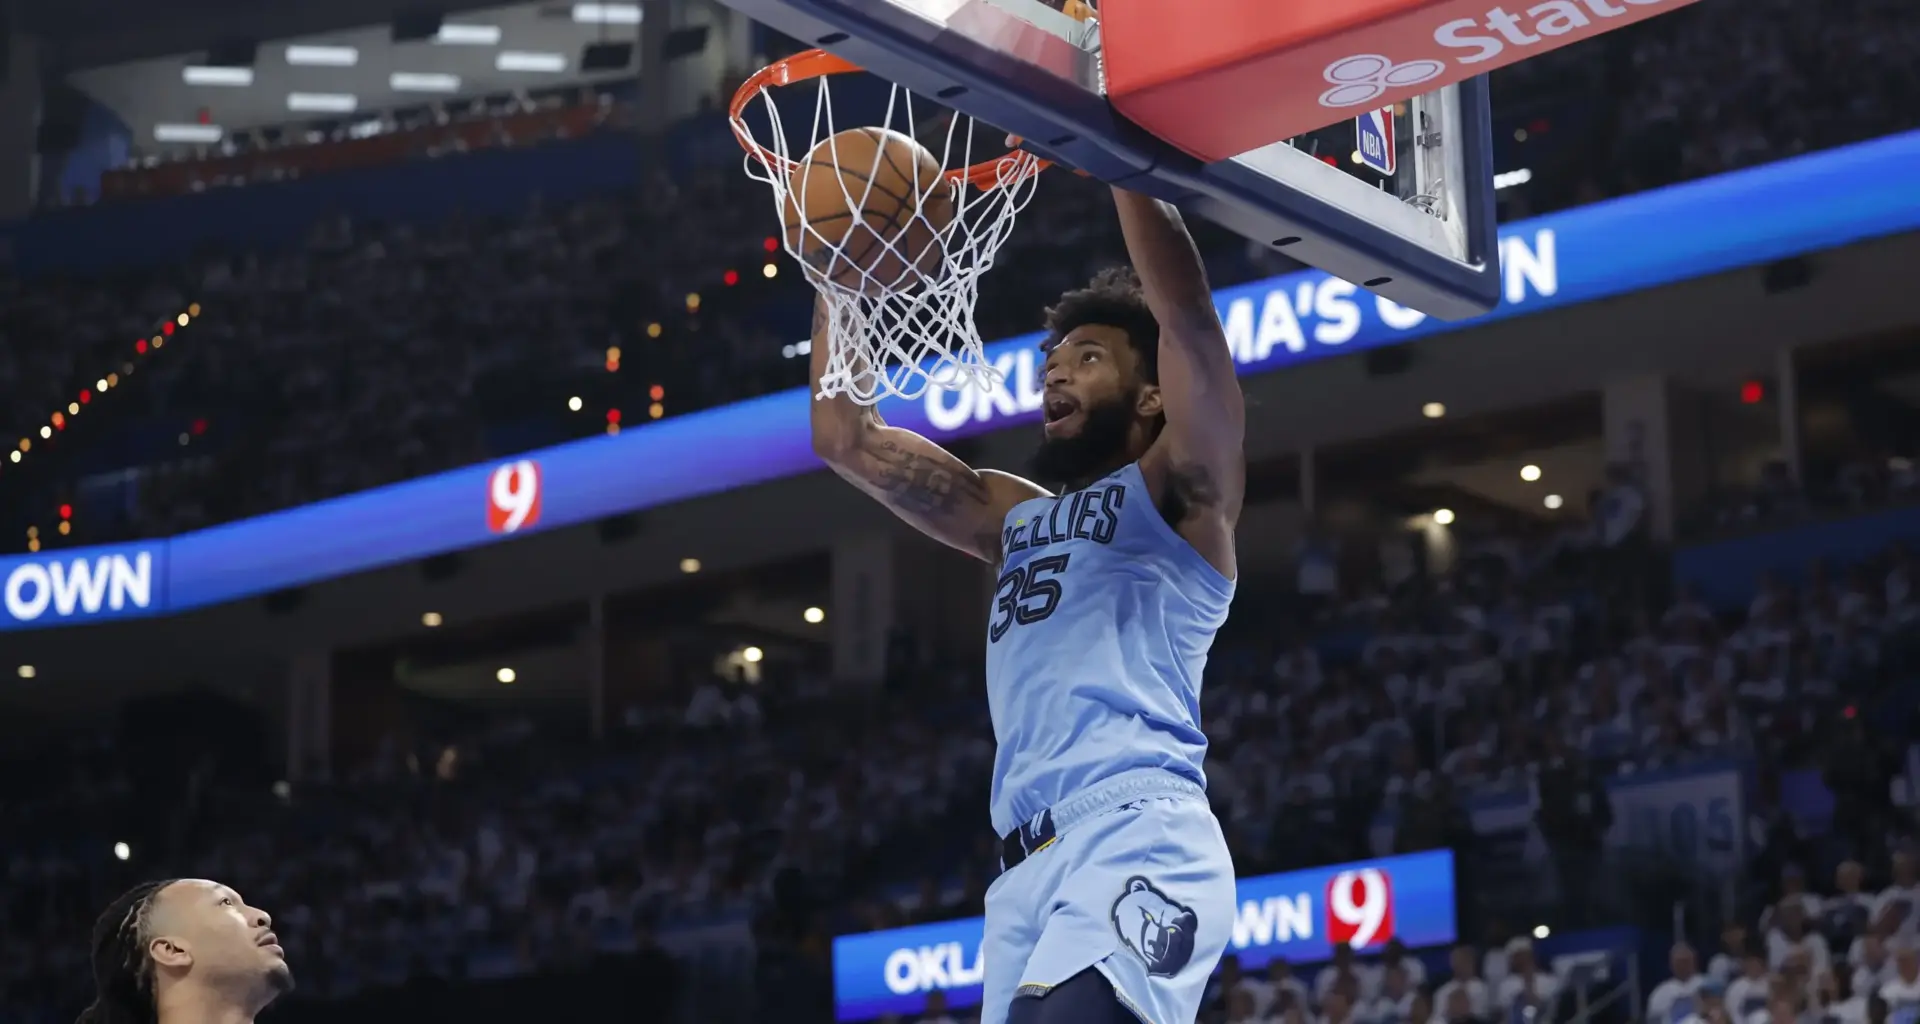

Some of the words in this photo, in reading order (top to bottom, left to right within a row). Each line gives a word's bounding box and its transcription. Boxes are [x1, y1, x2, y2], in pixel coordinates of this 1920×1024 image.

[1434, 0, 1661, 64] Stat
[1363, 130, 1381, 160] NBA
[491, 459, 538, 533] 9
[4, 551, 151, 621] OWN
[990, 553, 1071, 643] 35
[1232, 892, 1313, 949] WN
[1330, 868, 1388, 950] 9
